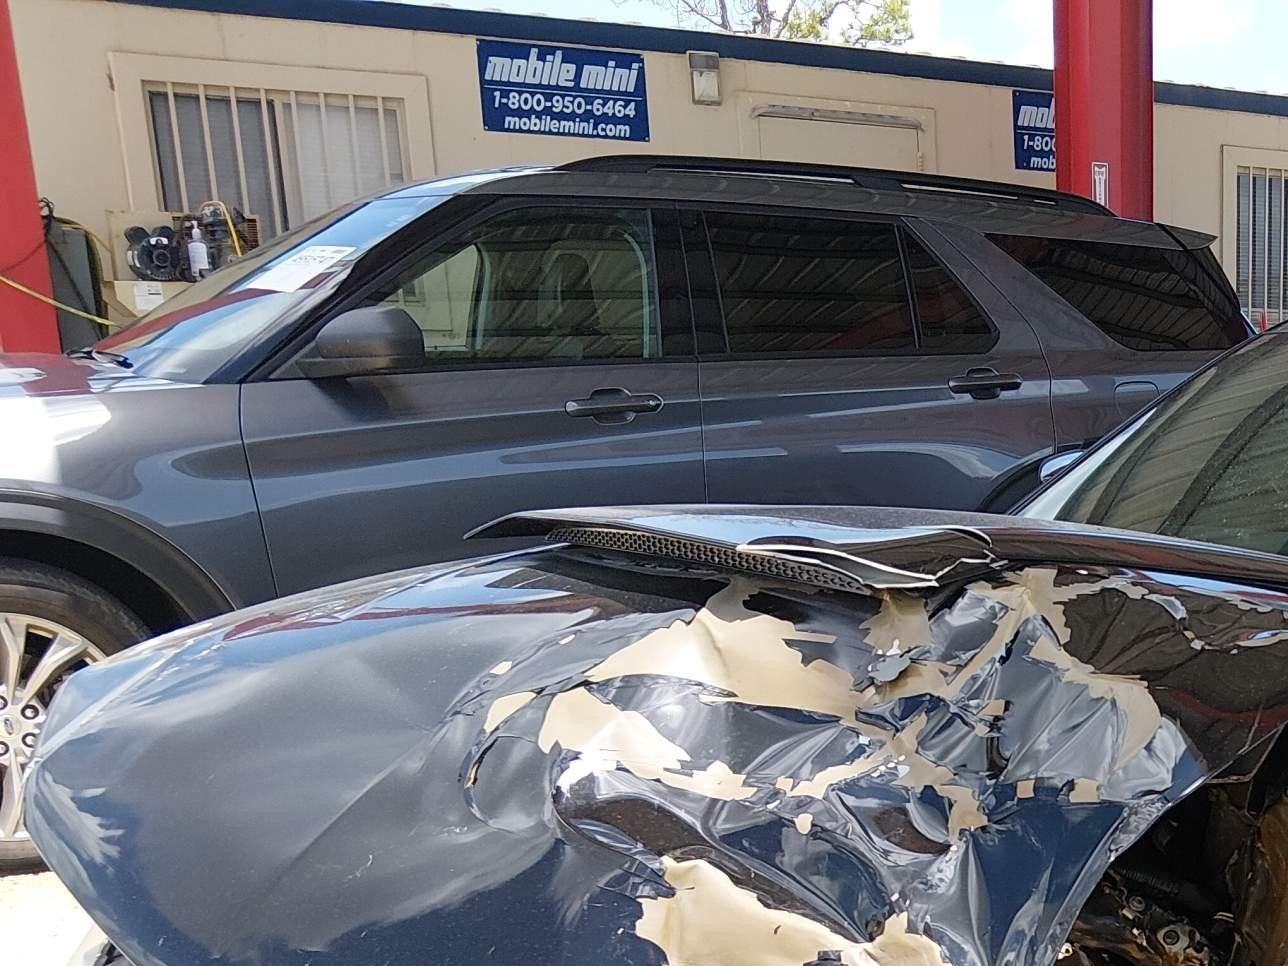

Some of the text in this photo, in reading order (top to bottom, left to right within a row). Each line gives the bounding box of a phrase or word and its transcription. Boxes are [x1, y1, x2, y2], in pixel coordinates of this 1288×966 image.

[484, 48, 640, 92] mobile mini
[493, 91, 636, 118] 1-800-950-6464
[504, 115, 631, 138] mobilemini.com
